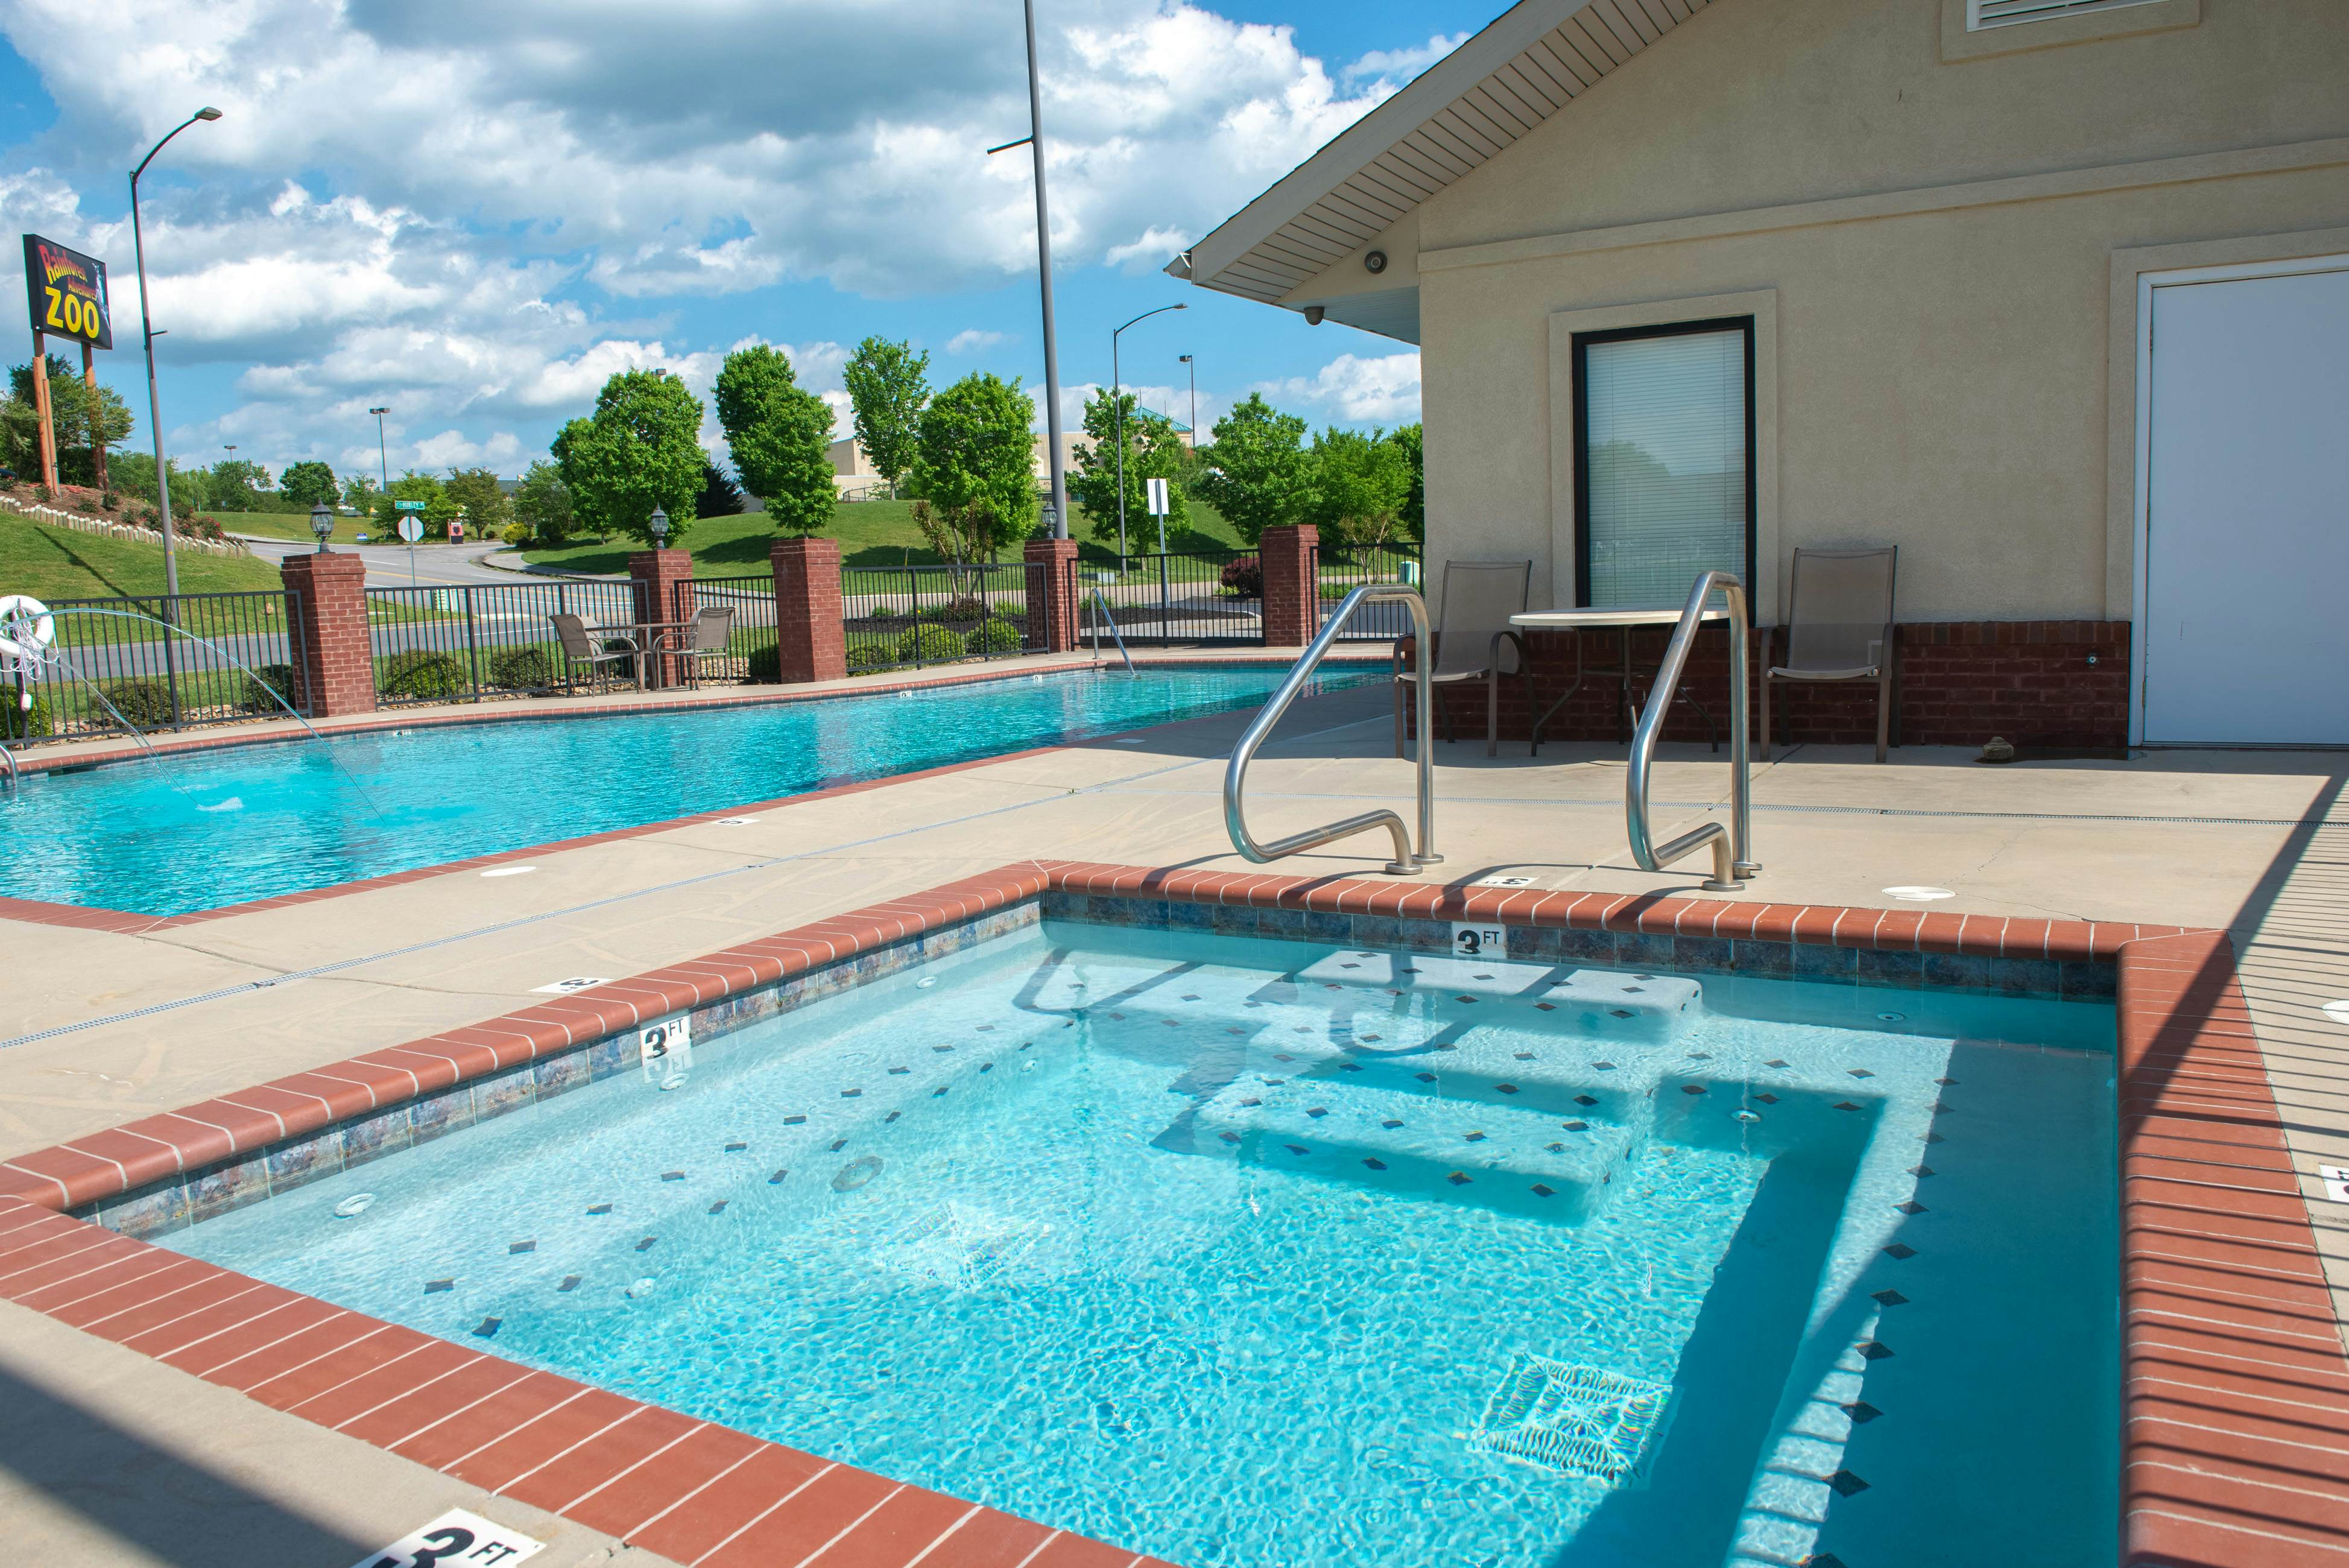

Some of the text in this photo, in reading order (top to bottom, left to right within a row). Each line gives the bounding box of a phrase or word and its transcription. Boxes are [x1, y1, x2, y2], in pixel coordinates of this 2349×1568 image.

[45, 285, 100, 338] ZOO
[1458, 929, 1500, 954] 3 FT
[645, 1018, 684, 1060] 3 FT
[370, 1527, 519, 1568] 3 FT
